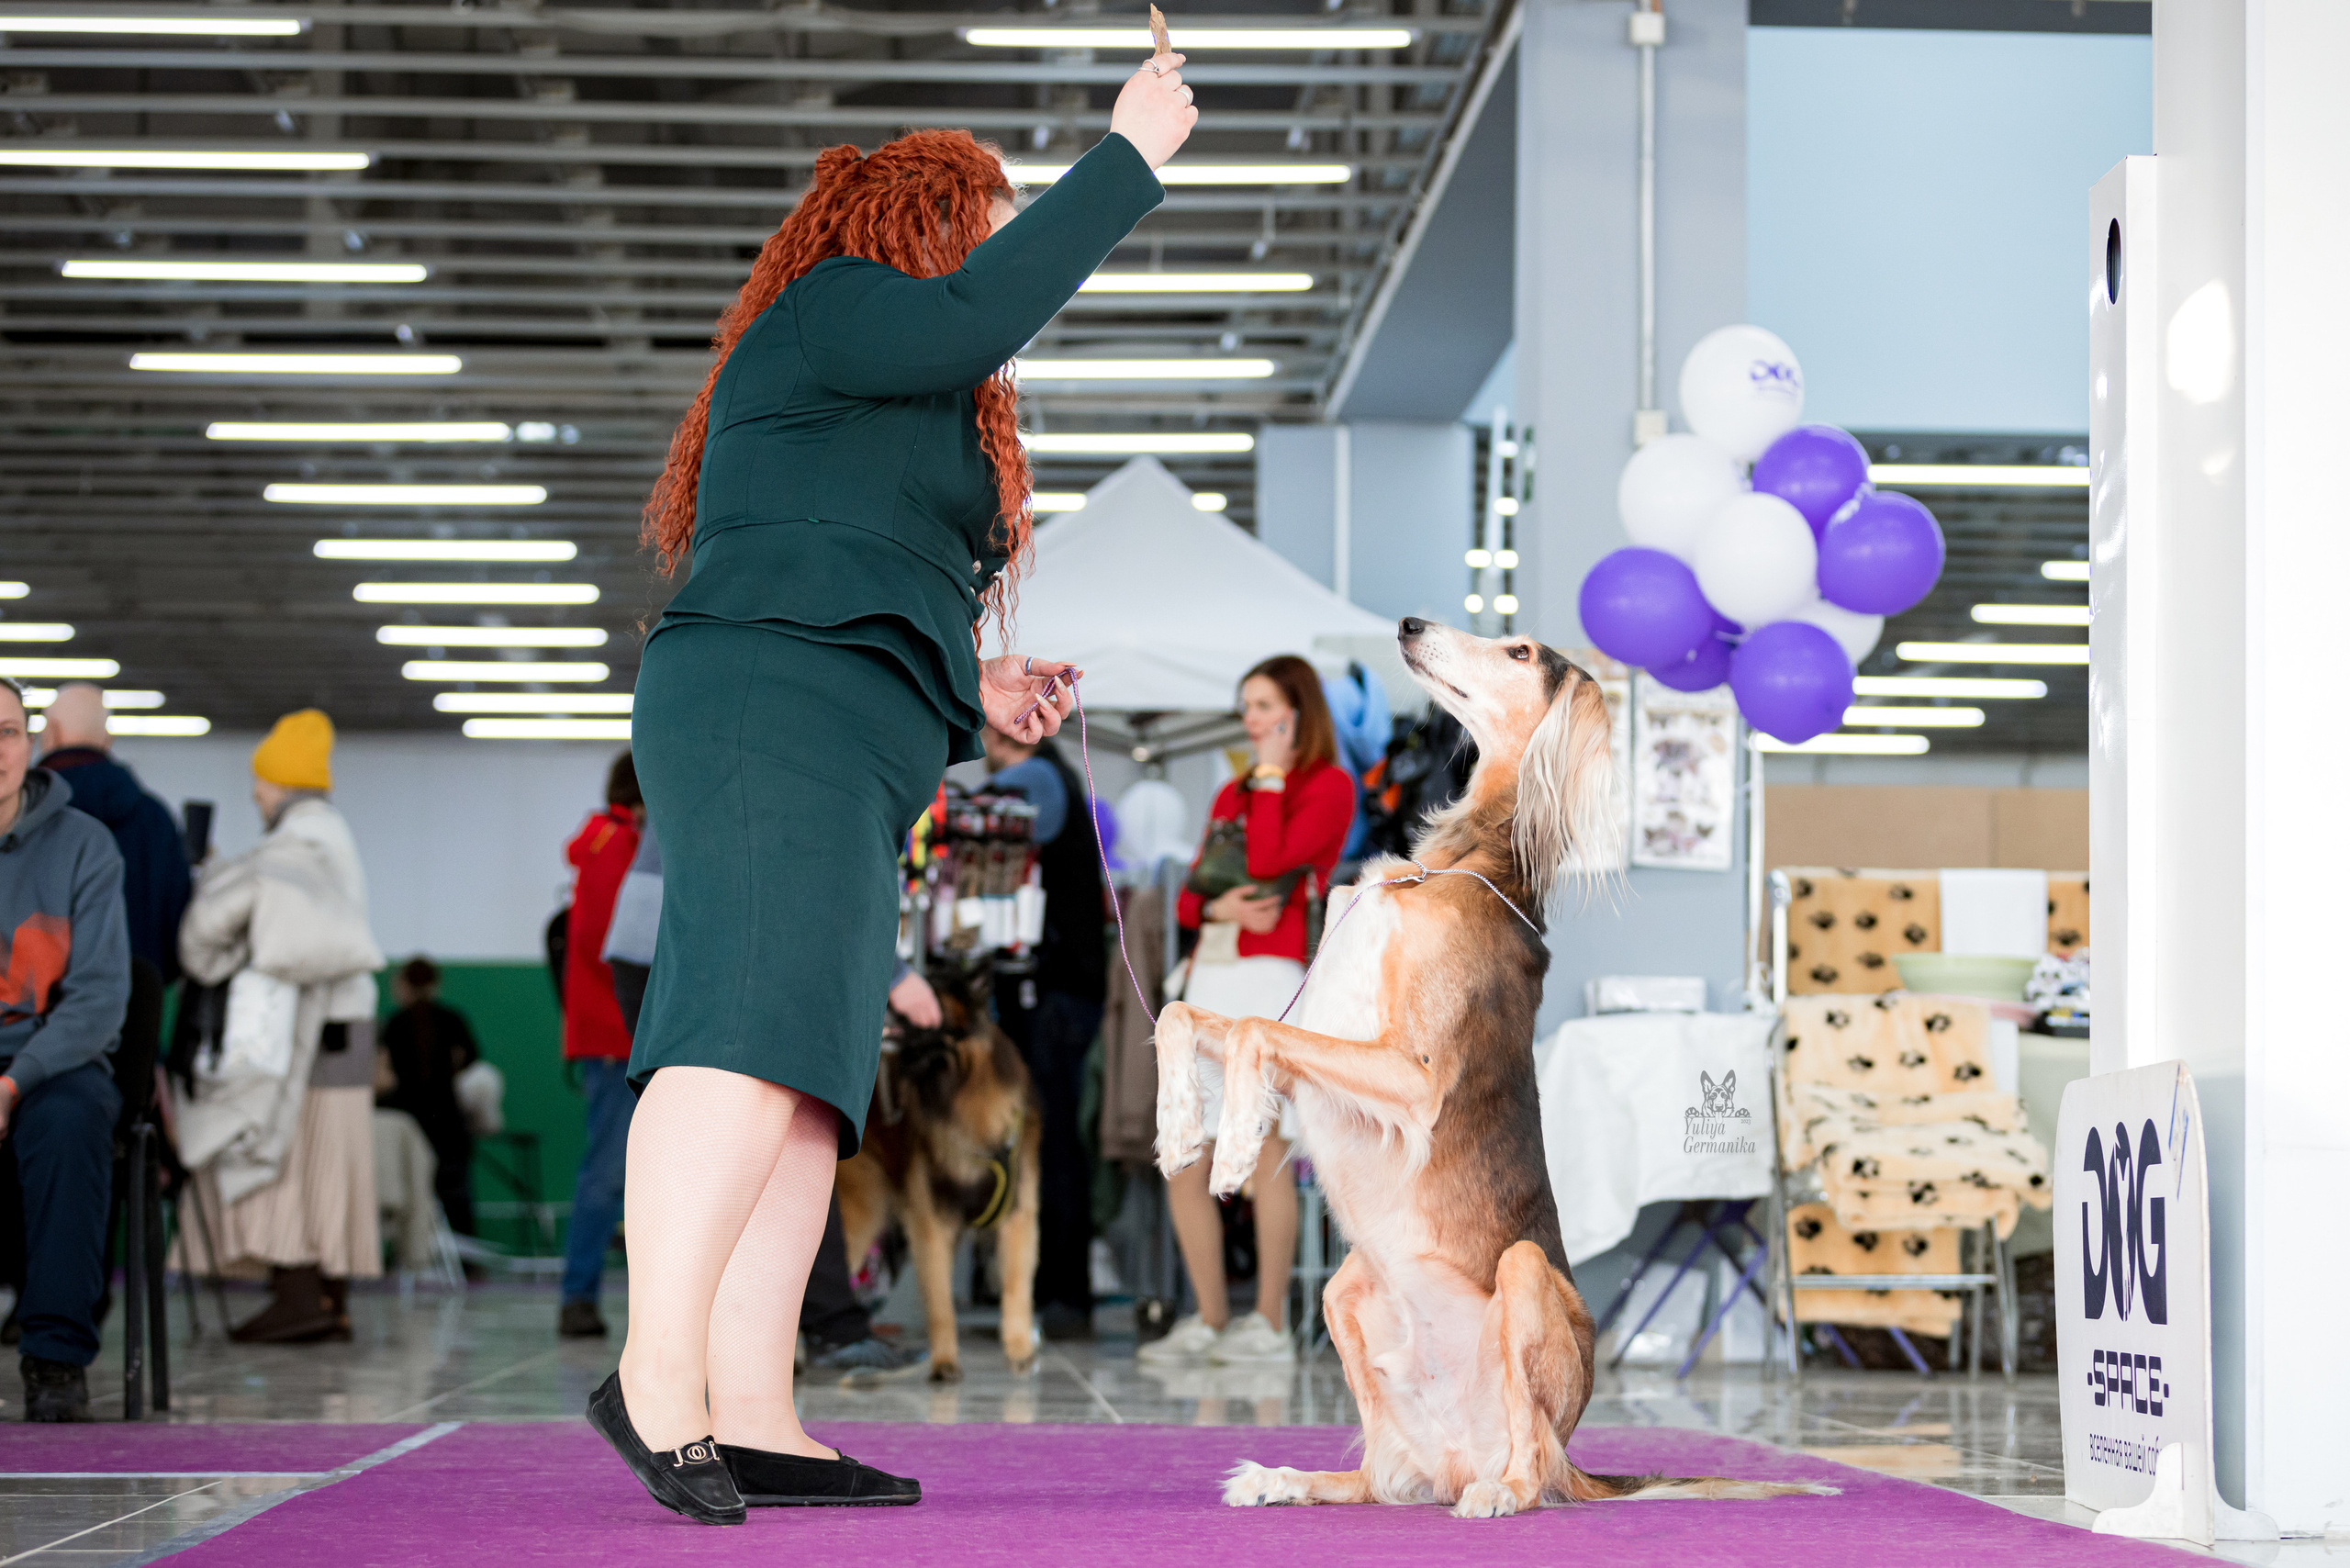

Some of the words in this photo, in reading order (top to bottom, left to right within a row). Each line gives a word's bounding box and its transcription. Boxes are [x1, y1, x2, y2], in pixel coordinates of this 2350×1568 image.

[2082, 1118, 2167, 1325] DOG
[2089, 1433, 2123, 1469] вселенная
[2123, 1433, 2147, 1474] вашей
